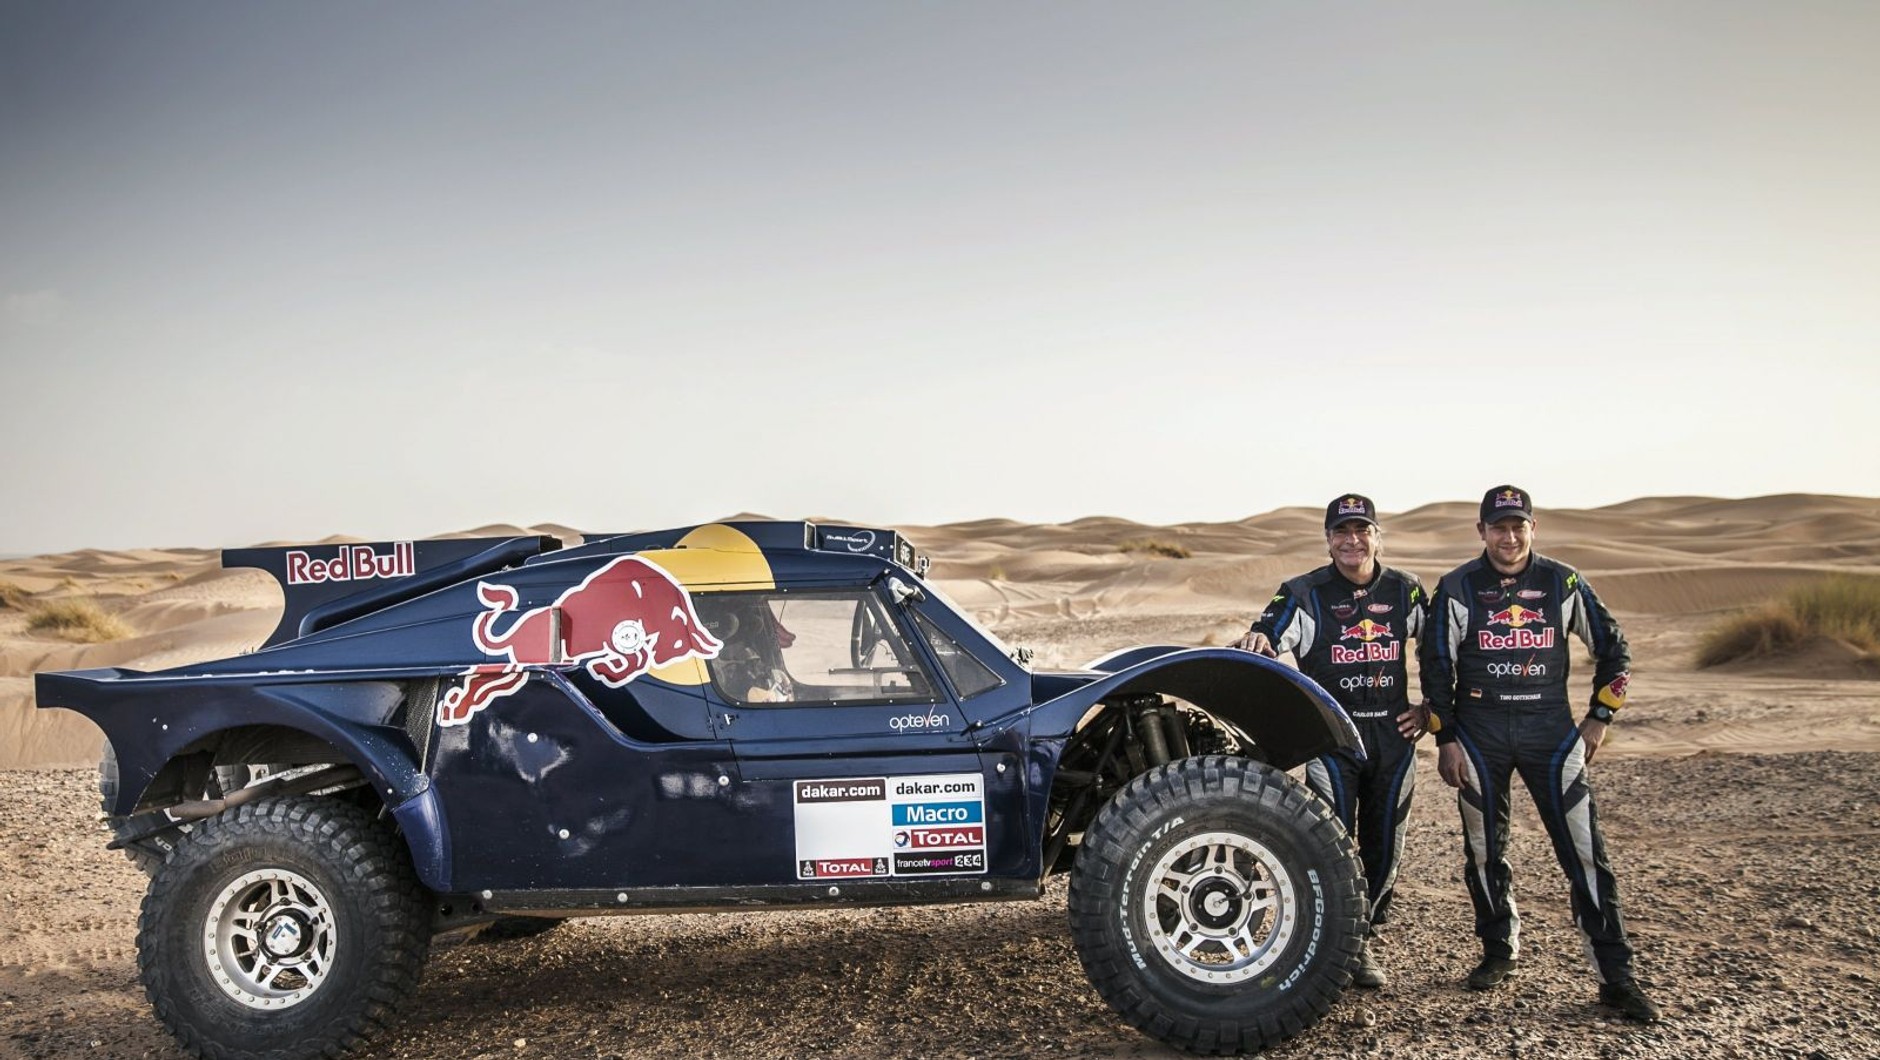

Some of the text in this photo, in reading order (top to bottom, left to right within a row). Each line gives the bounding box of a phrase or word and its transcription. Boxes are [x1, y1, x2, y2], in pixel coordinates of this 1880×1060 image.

[287, 541, 415, 584] Red Bull
[1478, 627, 1555, 650] Red Bull
[1331, 641, 1399, 664] Red Bull
[1487, 654, 1546, 678] opteven
[1340, 666, 1393, 692] opteven
[889, 704, 950, 734] opteven
[801, 785, 881, 799] dakar.com
[896, 781, 976, 795] dakar.com
[906, 805, 968, 823] Macro
[914, 829, 981, 845] TOTAL
[819, 860, 871, 874] TOTAL
[1120, 816, 1185, 970] Mud-Terrain T/A
[1280, 869, 1324, 991] BFGoodrich
